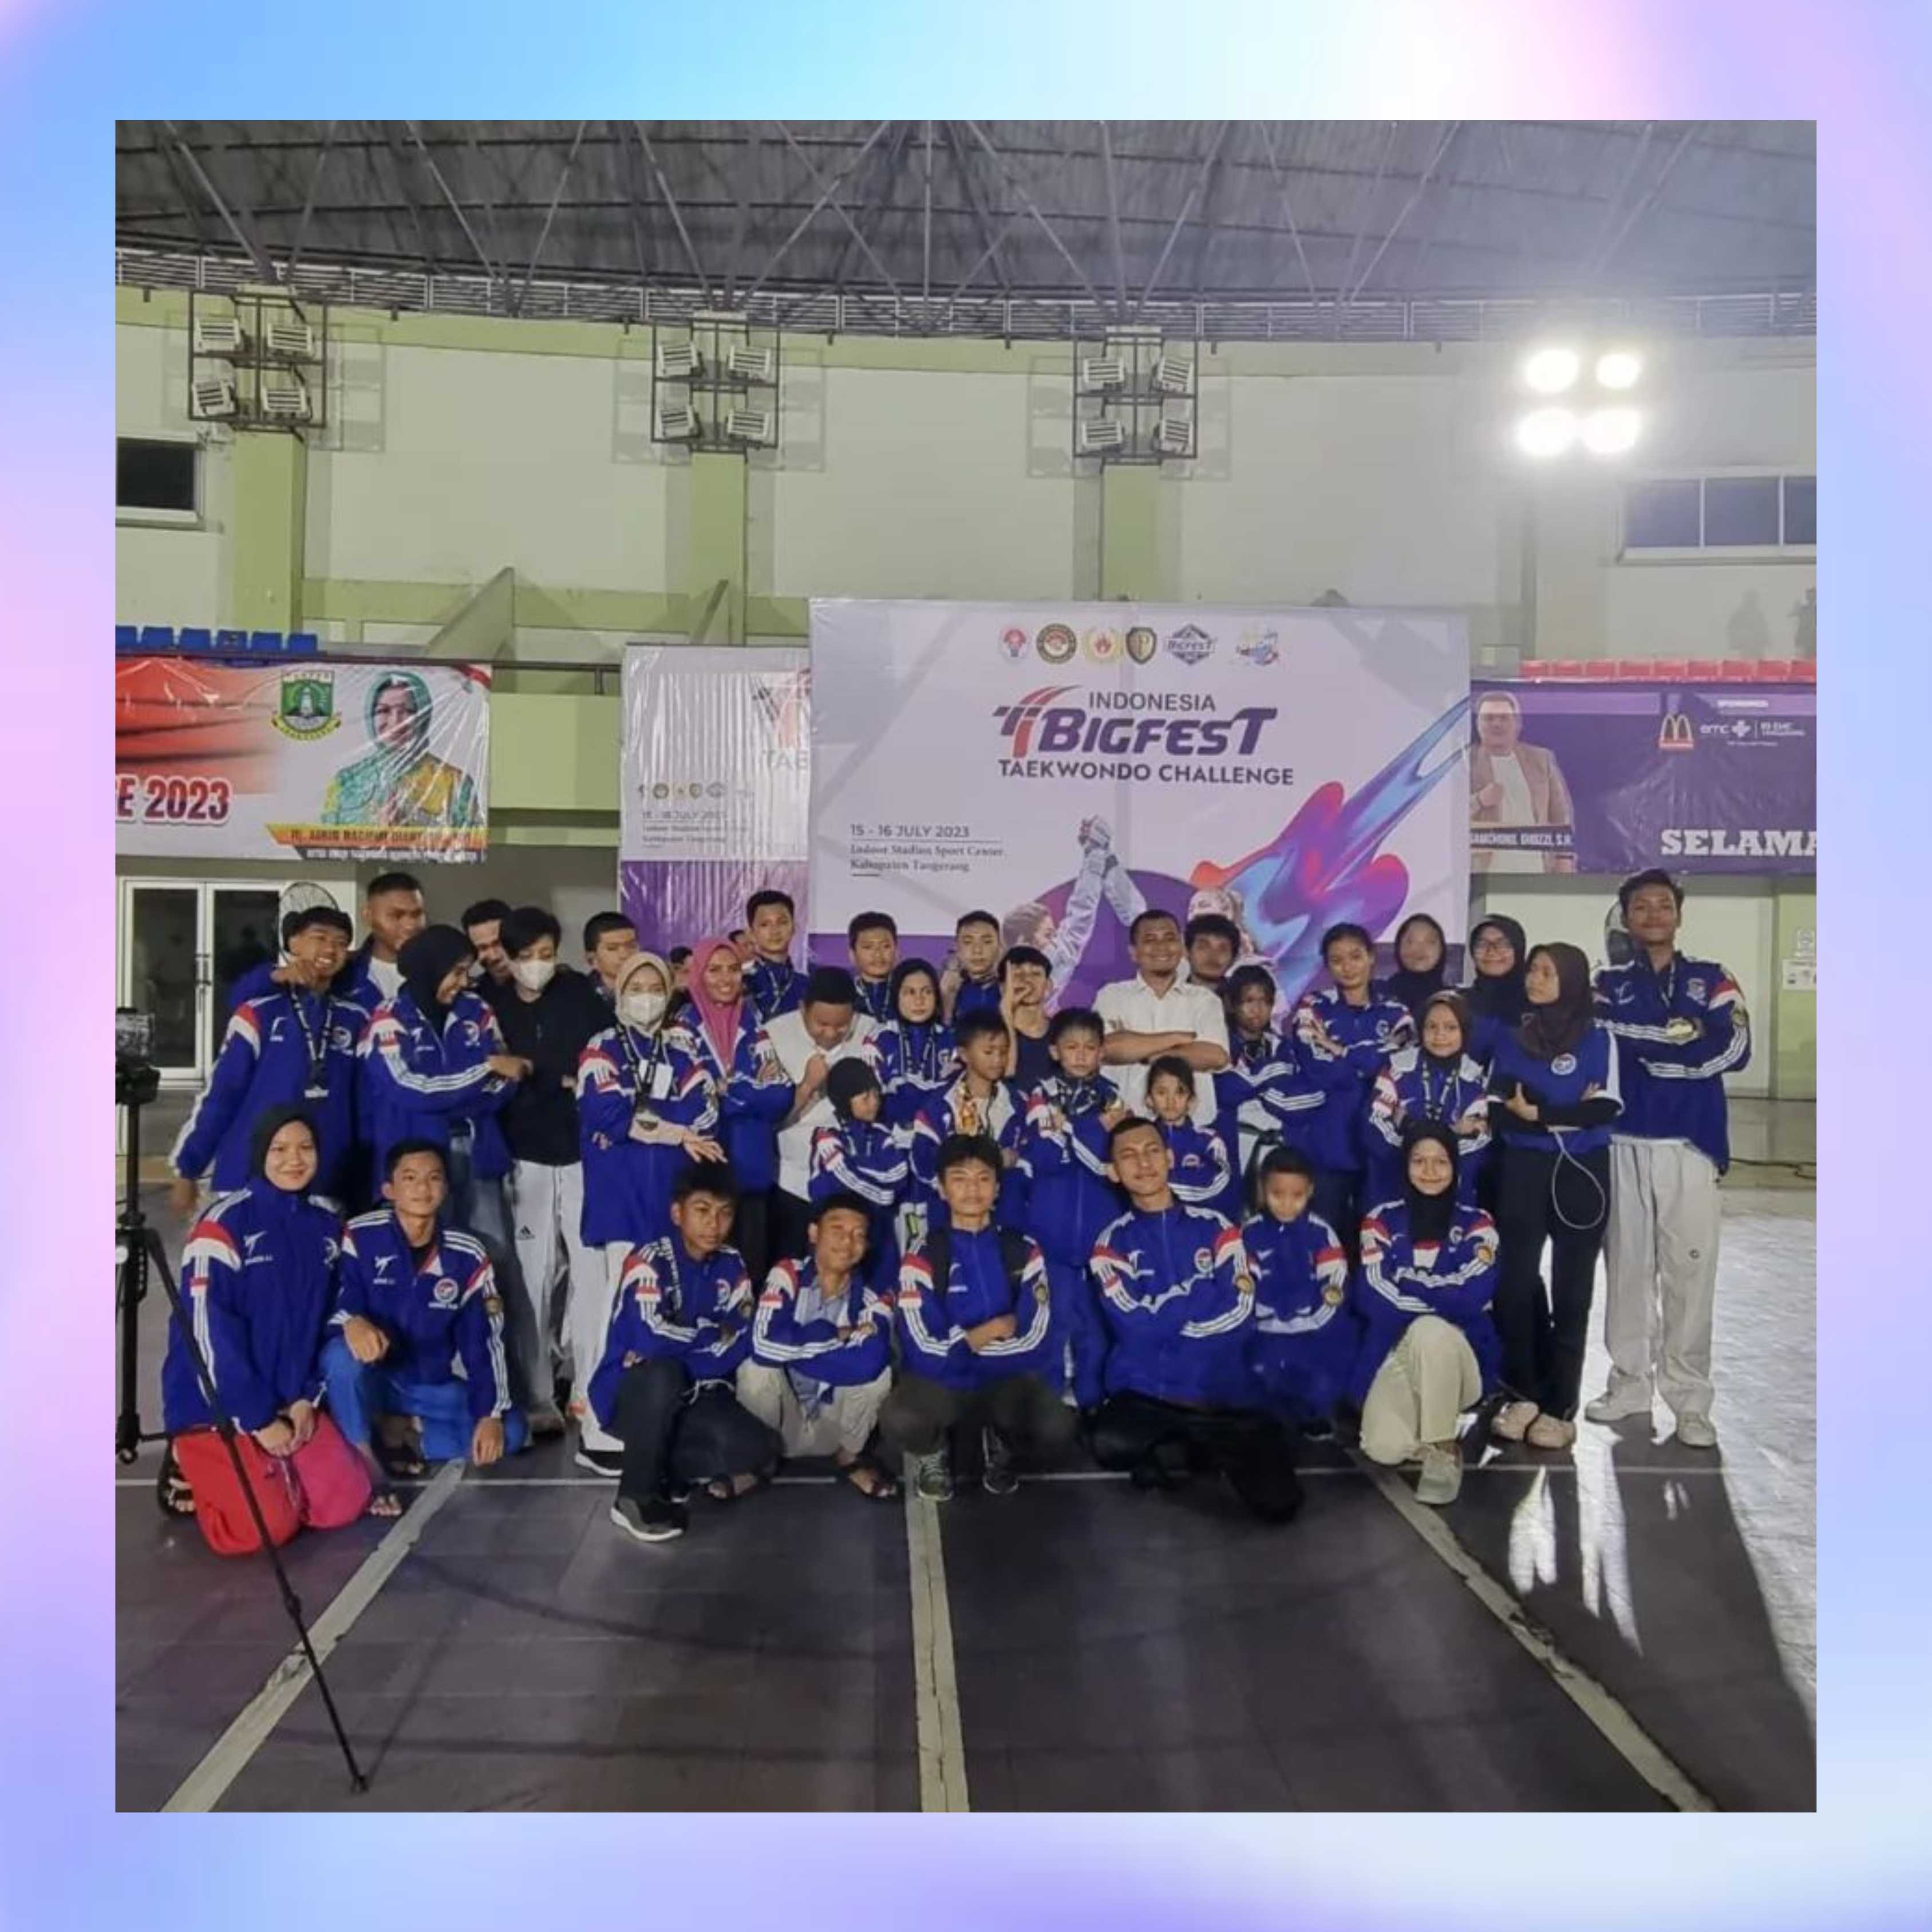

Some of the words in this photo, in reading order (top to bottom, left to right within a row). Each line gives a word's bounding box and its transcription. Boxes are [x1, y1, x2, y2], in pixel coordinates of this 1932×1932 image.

[1089, 692, 1216, 712] INDONESIA
[1038, 708, 1278, 755] BIGFEST
[998, 759, 1151, 781] TAEKWONDO
[1158, 764, 1294, 786] CHALLENGE
[145, 779, 228, 820] 2023
[851, 824, 864, 836] 15
[879, 824, 892, 837] 16
[896, 825, 932, 837] JULY
[936, 825, 970, 838] 2023
